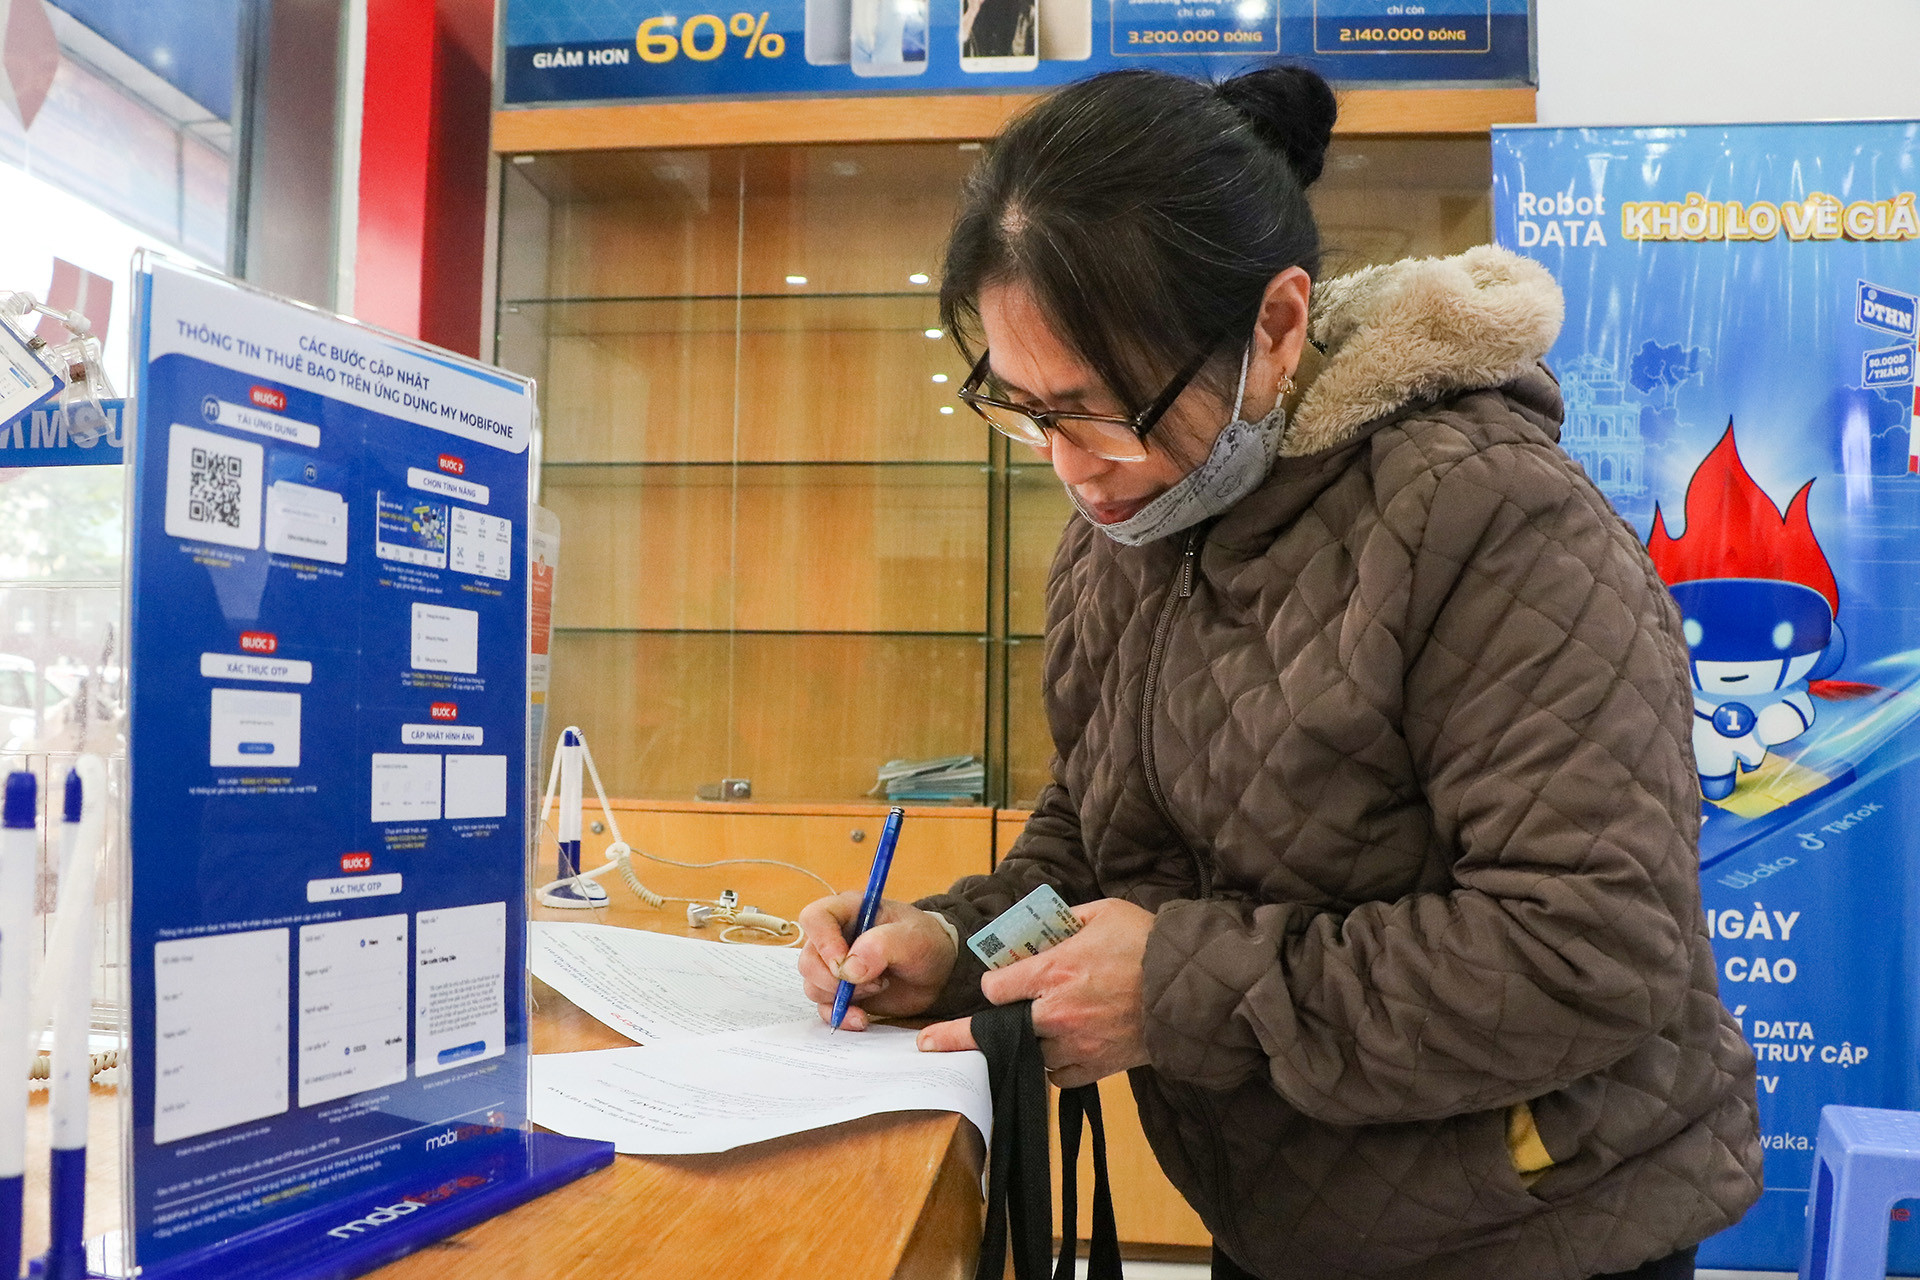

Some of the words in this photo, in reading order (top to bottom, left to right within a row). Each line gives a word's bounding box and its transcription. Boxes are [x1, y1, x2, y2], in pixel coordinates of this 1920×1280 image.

[532, 47, 584, 69] GIẢM
[587, 47, 630, 66] HƠN
[635, 11, 786, 63] 60%
[1127, 30, 1220, 44] 3.200.000
[1339, 28, 1424, 42] 2.140.000
[1518, 191, 1606, 216] Robot
[1727, 205, 1777, 236] LO
[1784, 196, 1839, 235] VỀ
[1847, 196, 1918, 236] GIÁ
[1518, 220, 1608, 247] DATA
[298, 335, 328, 357] CÁC
[329, 346, 366, 370] BƯỚC
[369, 358, 394, 382] CẬP
[397, 368, 430, 392] NHẬT
[176, 319, 233, 351] THÔNG
[236, 338, 261, 360] TIN
[264, 347, 304, 373] THUÊ
[306, 361, 337, 383] BAO
[338, 371, 371, 394] TRÊN
[374, 378, 400, 404] ỨNG
[403, 393, 438, 415] DỤNG
[440, 403, 458, 420] MY
[459, 411, 514, 439] MOBIFONE
[270, 665, 289, 677] OTP
[451, 708, 457, 718] 4
[1726, 710, 1741, 731] 1
[1820, 801, 1884, 835] TikTok
[364, 856, 371, 869] 5
[1717, 856, 1799, 890] Waka
[367, 881, 382, 892] OTP
[1724, 956, 1798, 984] CAO
[1753, 1020, 1815, 1040] DATA
[1752, 1043, 1816, 1063] TRUY
[1820, 1041, 1869, 1069] CẬP
